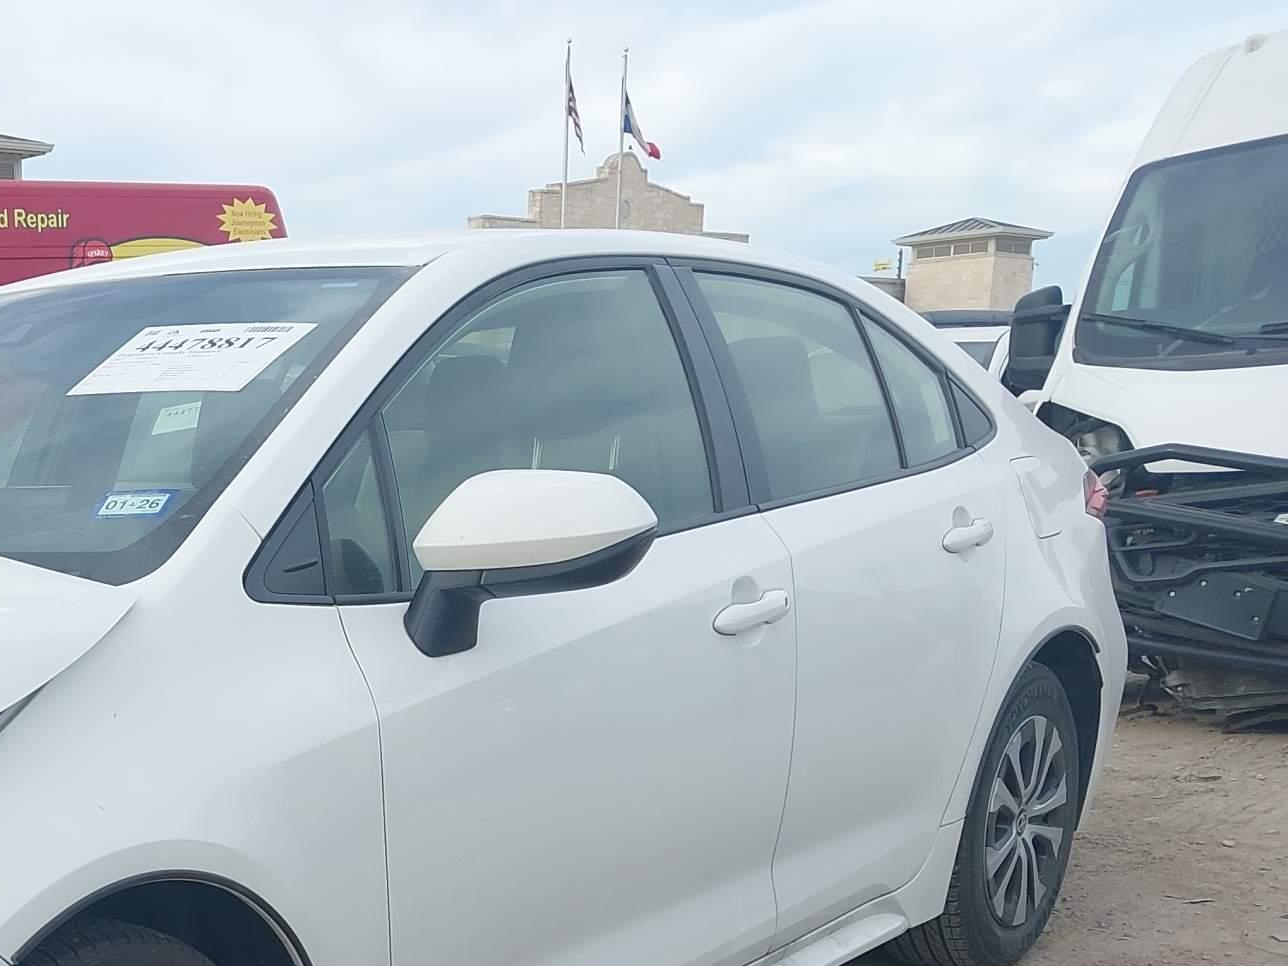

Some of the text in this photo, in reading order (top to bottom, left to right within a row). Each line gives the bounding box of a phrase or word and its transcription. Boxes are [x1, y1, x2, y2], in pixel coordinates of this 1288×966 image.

[14, 208, 70, 233] Repair
[135, 336, 279, 352] 44478817
[104, 497, 162, 511] 01-26
